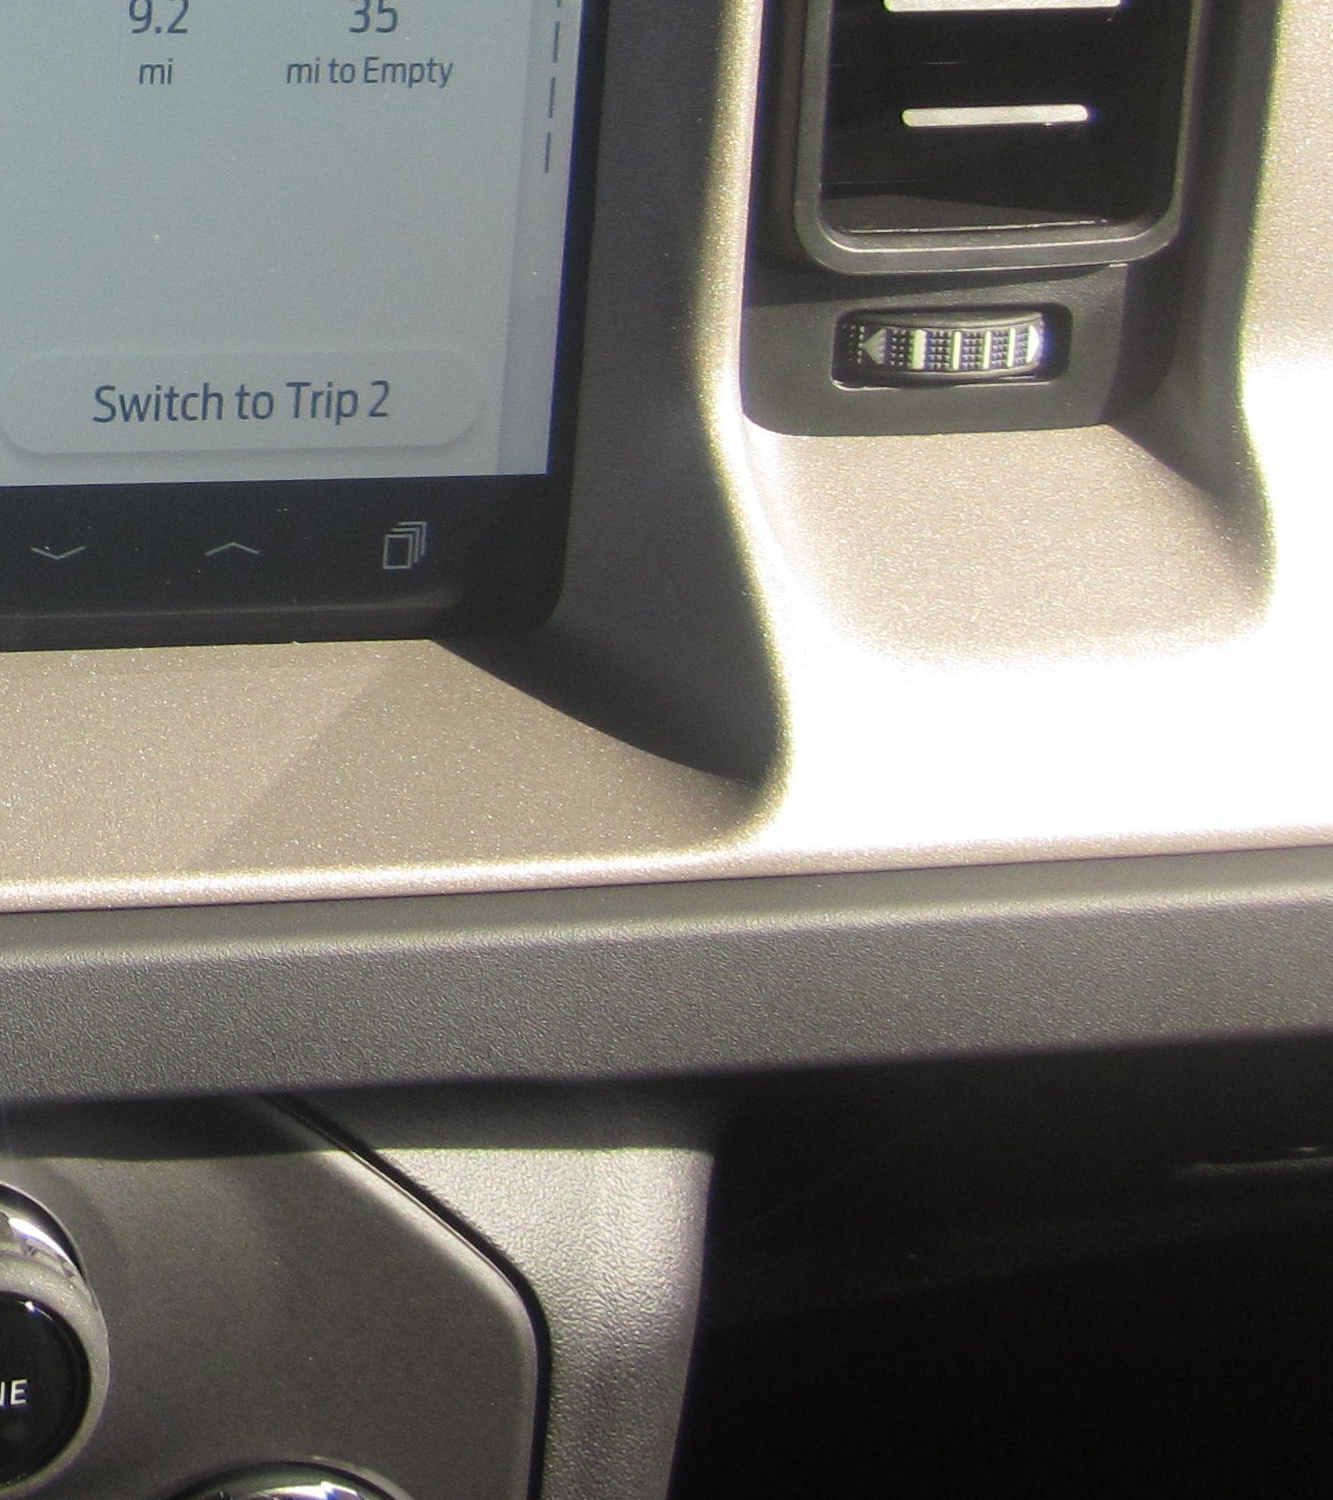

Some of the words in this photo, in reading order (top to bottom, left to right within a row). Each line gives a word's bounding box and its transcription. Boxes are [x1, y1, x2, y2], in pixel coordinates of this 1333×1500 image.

[138, 57, 174, 86] mi
[285, 56, 321, 86] mi
[326, 58, 357, 85] to
[363, 56, 454, 89] Empty
[93, 381, 224, 424] Switch
[234, 385, 275, 420] to
[285, 378, 359, 426] Trip
[368, 379, 391, 418] 2
